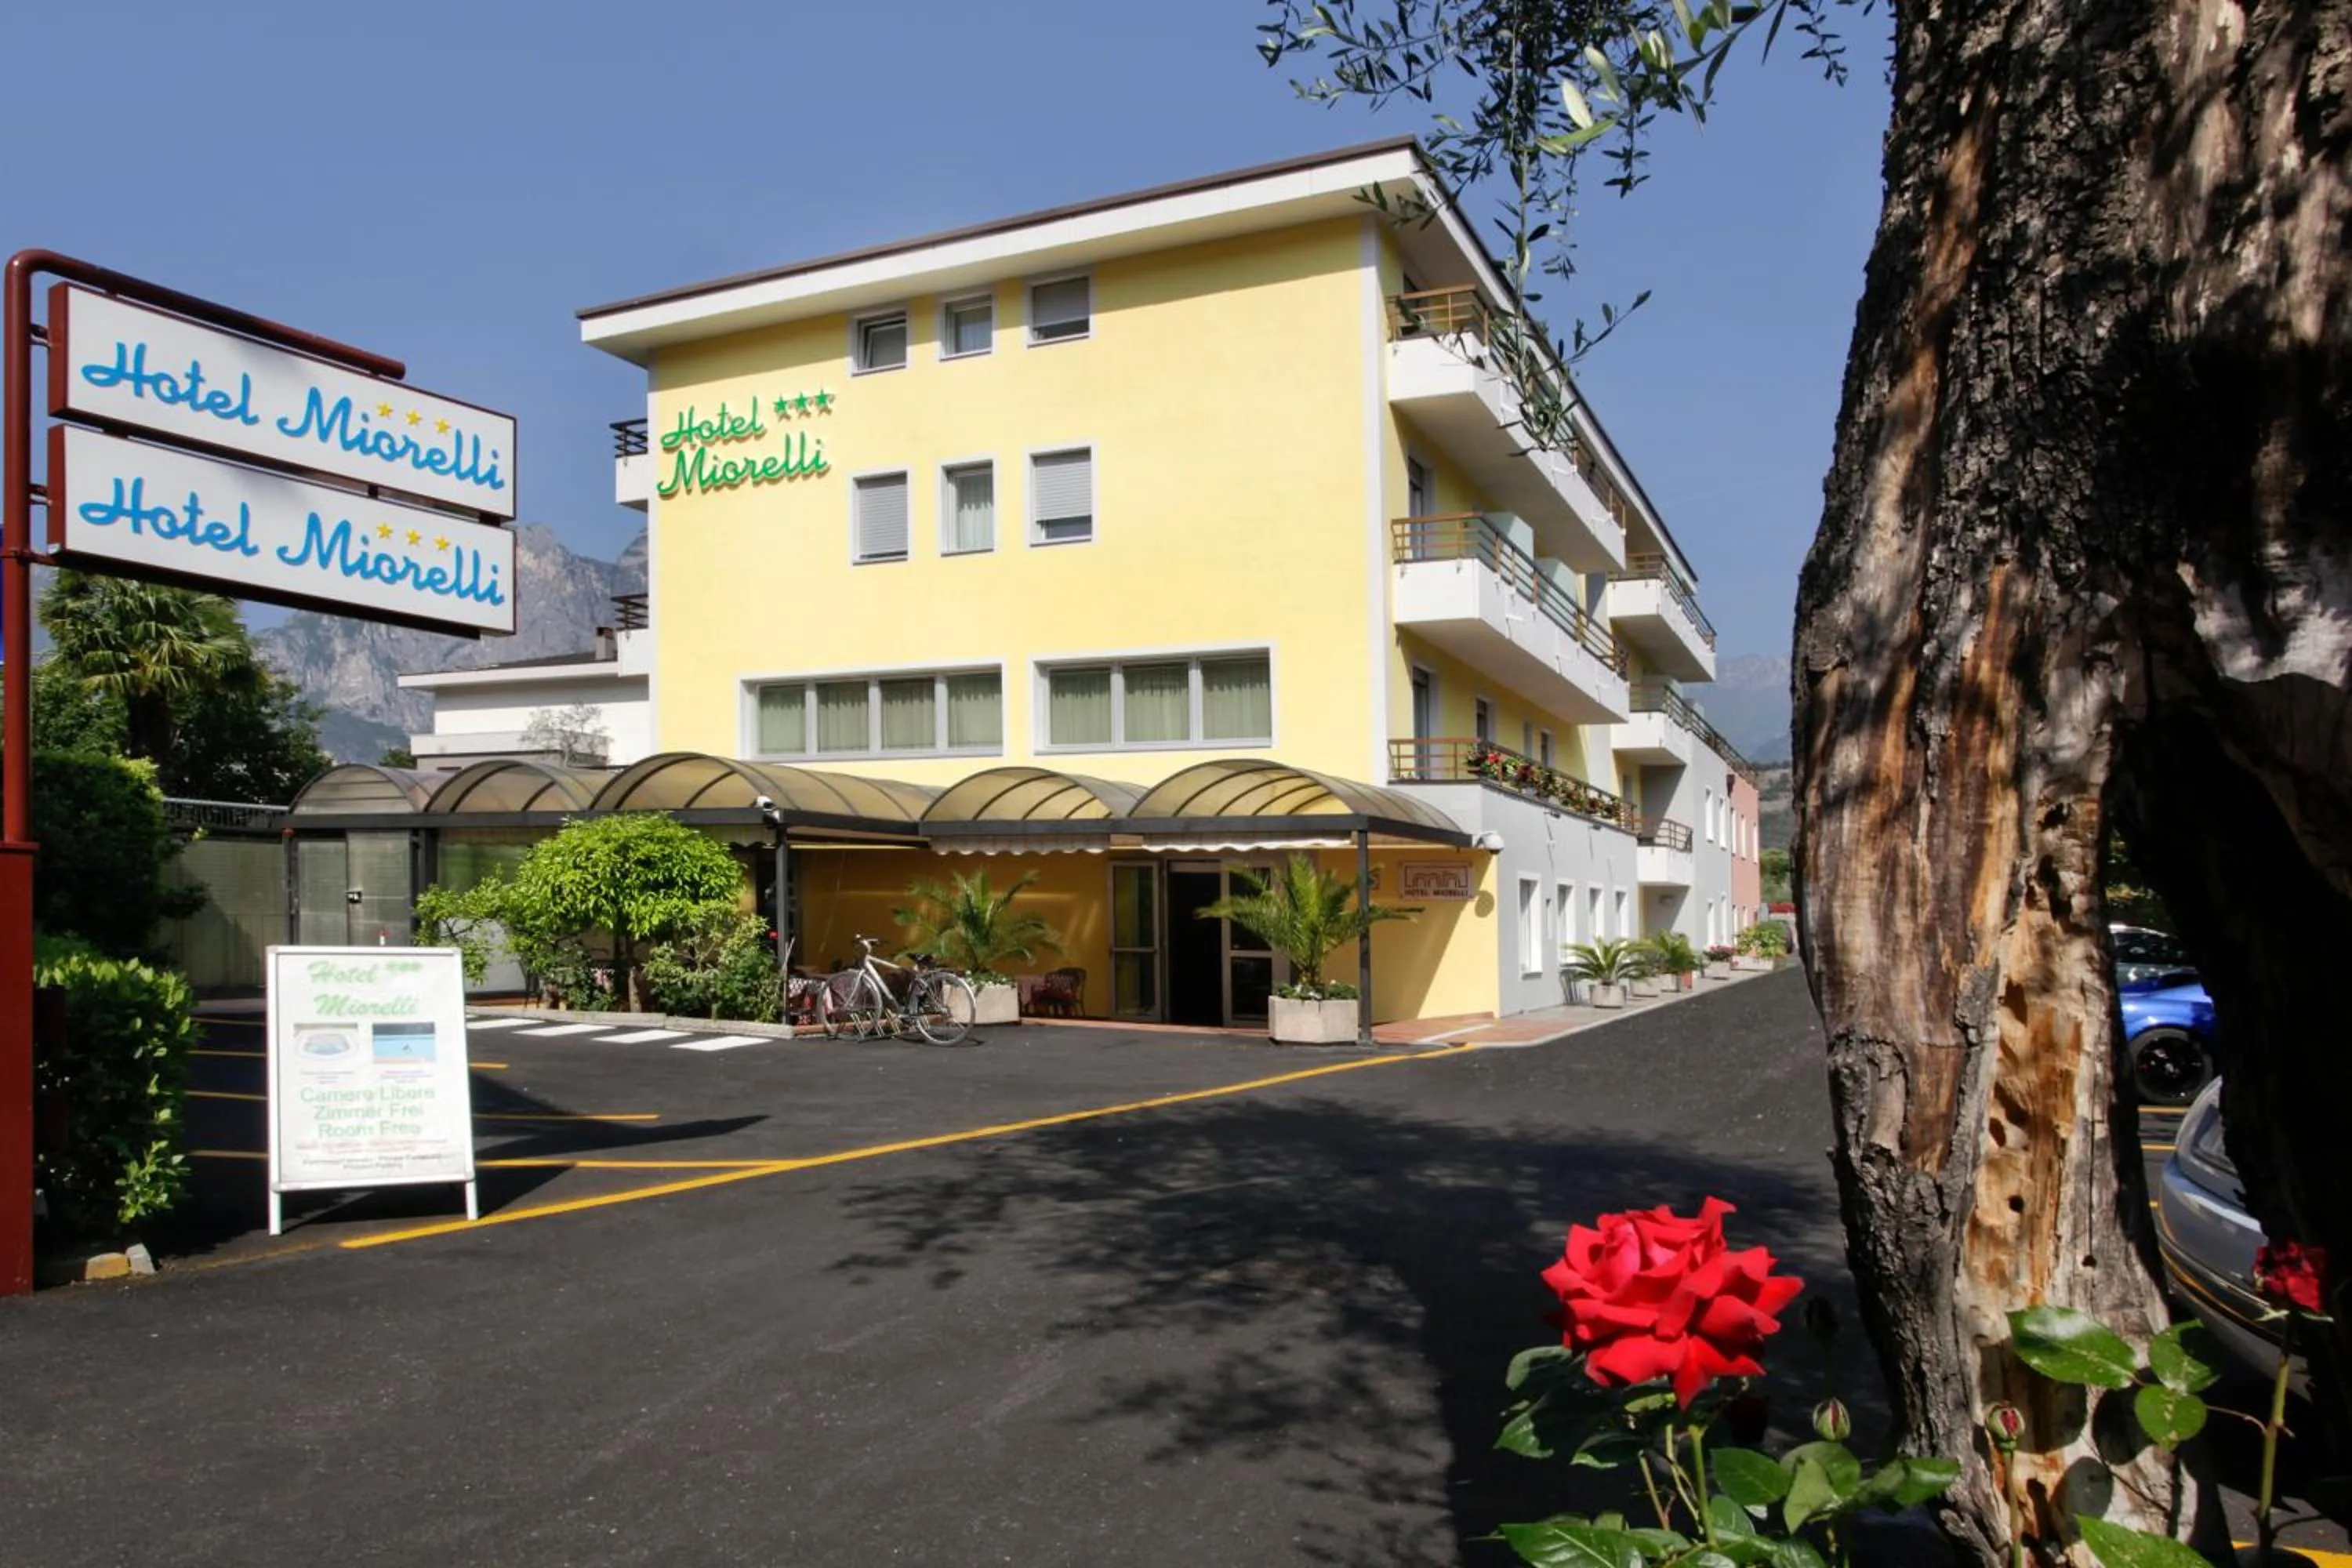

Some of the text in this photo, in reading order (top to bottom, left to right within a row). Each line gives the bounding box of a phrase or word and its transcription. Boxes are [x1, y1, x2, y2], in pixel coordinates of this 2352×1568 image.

[82, 342, 504, 490] Hotel Miorelli
[660, 396, 764, 447] Hotel
[656, 430, 829, 497] Miorelli
[79, 477, 504, 606] Hotel Miorelli
[307, 960, 379, 983] Hotel
[314, 993, 419, 1017] Miorelli
[314, 1103, 424, 1120] Zimmer Frei
[318, 1120, 422, 1138] Room Free
